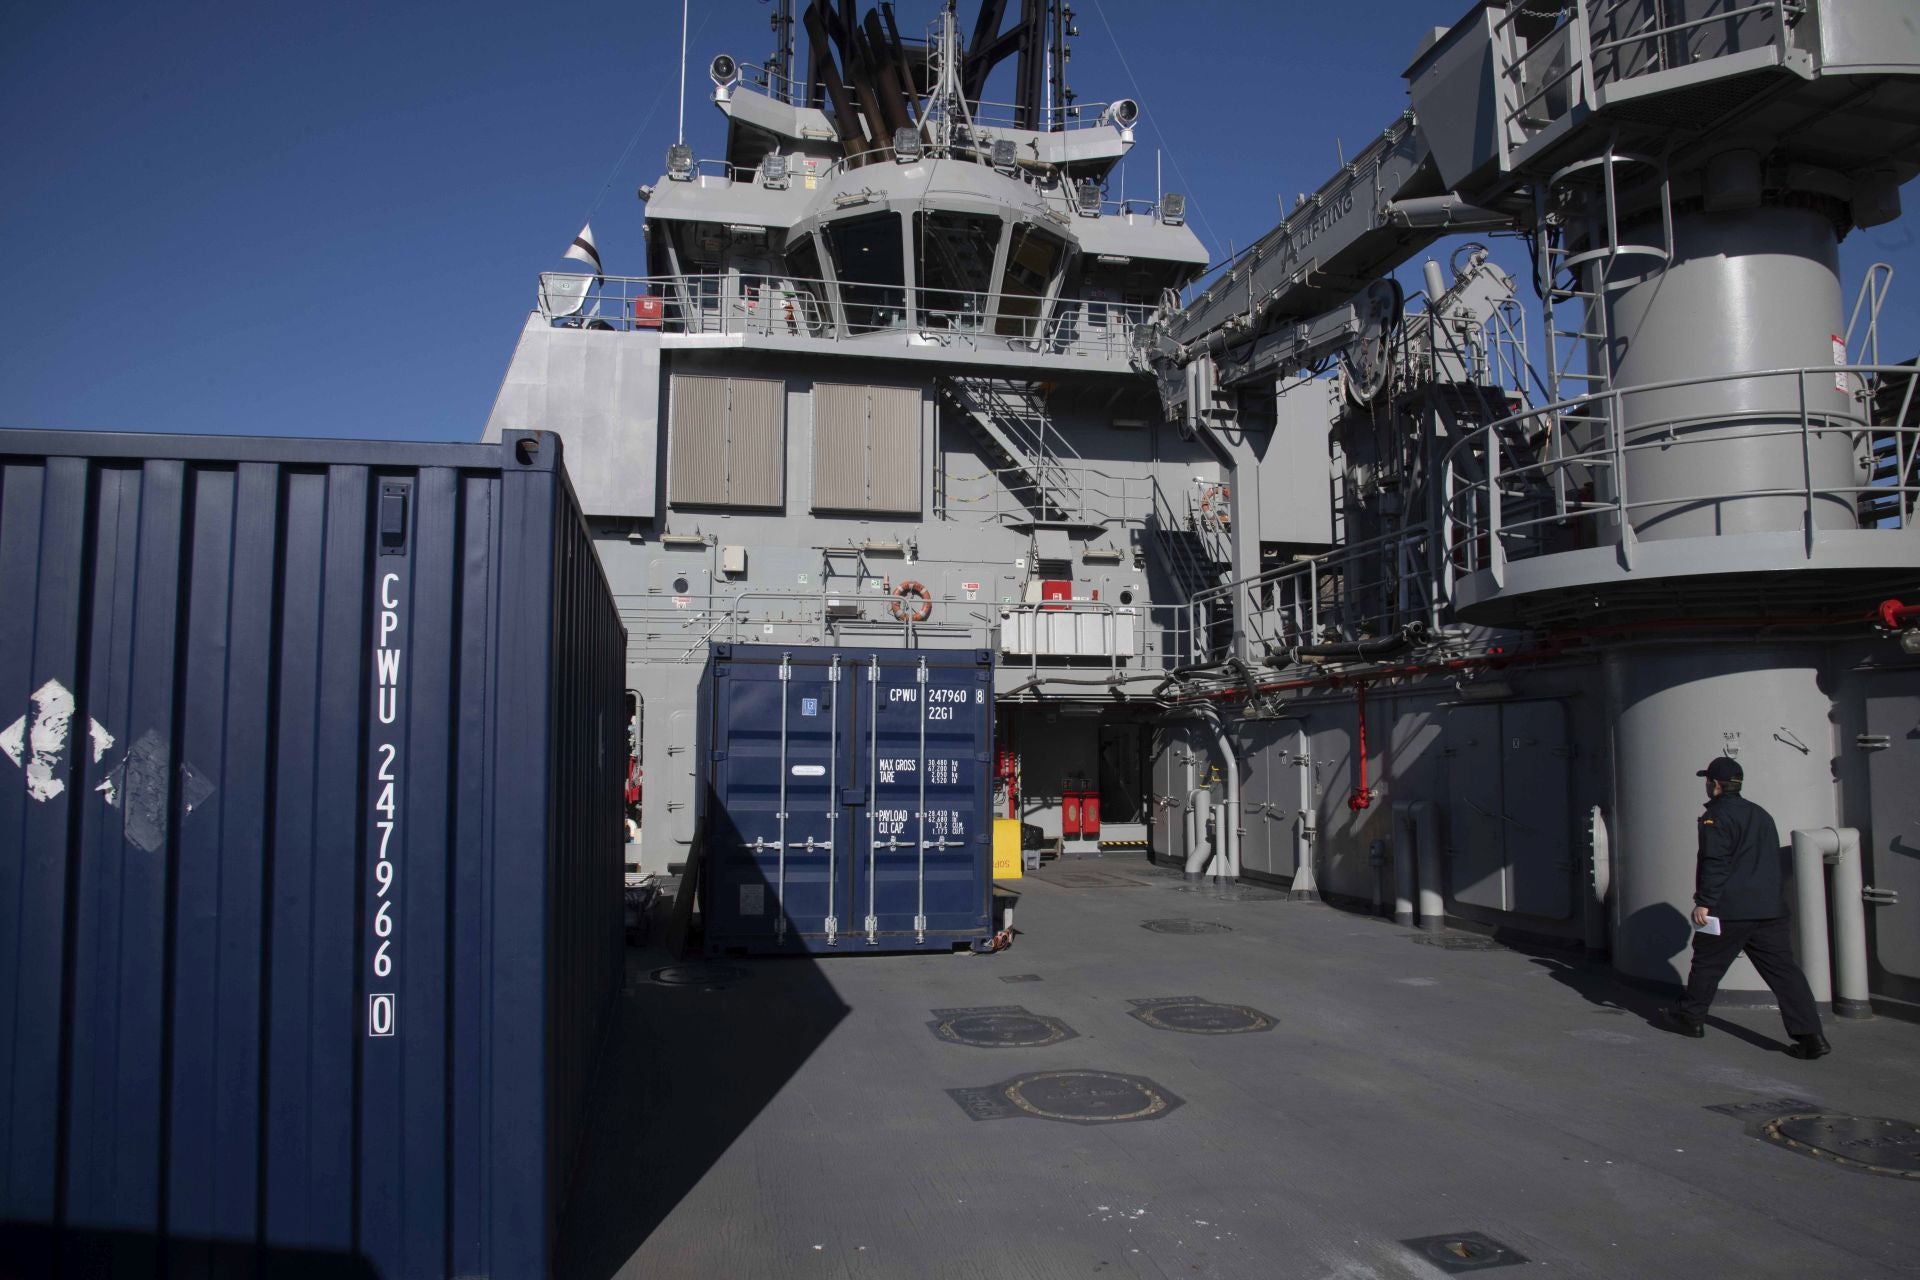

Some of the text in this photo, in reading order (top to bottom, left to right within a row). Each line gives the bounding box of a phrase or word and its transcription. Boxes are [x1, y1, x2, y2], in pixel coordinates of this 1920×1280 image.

[1301, 190, 1354, 250] LIFTING
[377, 573, 400, 723] CPWU
[889, 688, 983, 703] CPWU 247960 8
[928, 706, 953, 720] 22G1
[879, 759, 916, 771] MAX GROSS
[880, 771, 895, 783] TARE
[879, 810, 908, 822] PAYLOAD
[879, 822, 905, 834] CU. CAP.
[374, 743, 396, 978] 247966
[372, 996, 391, 1034] 0
